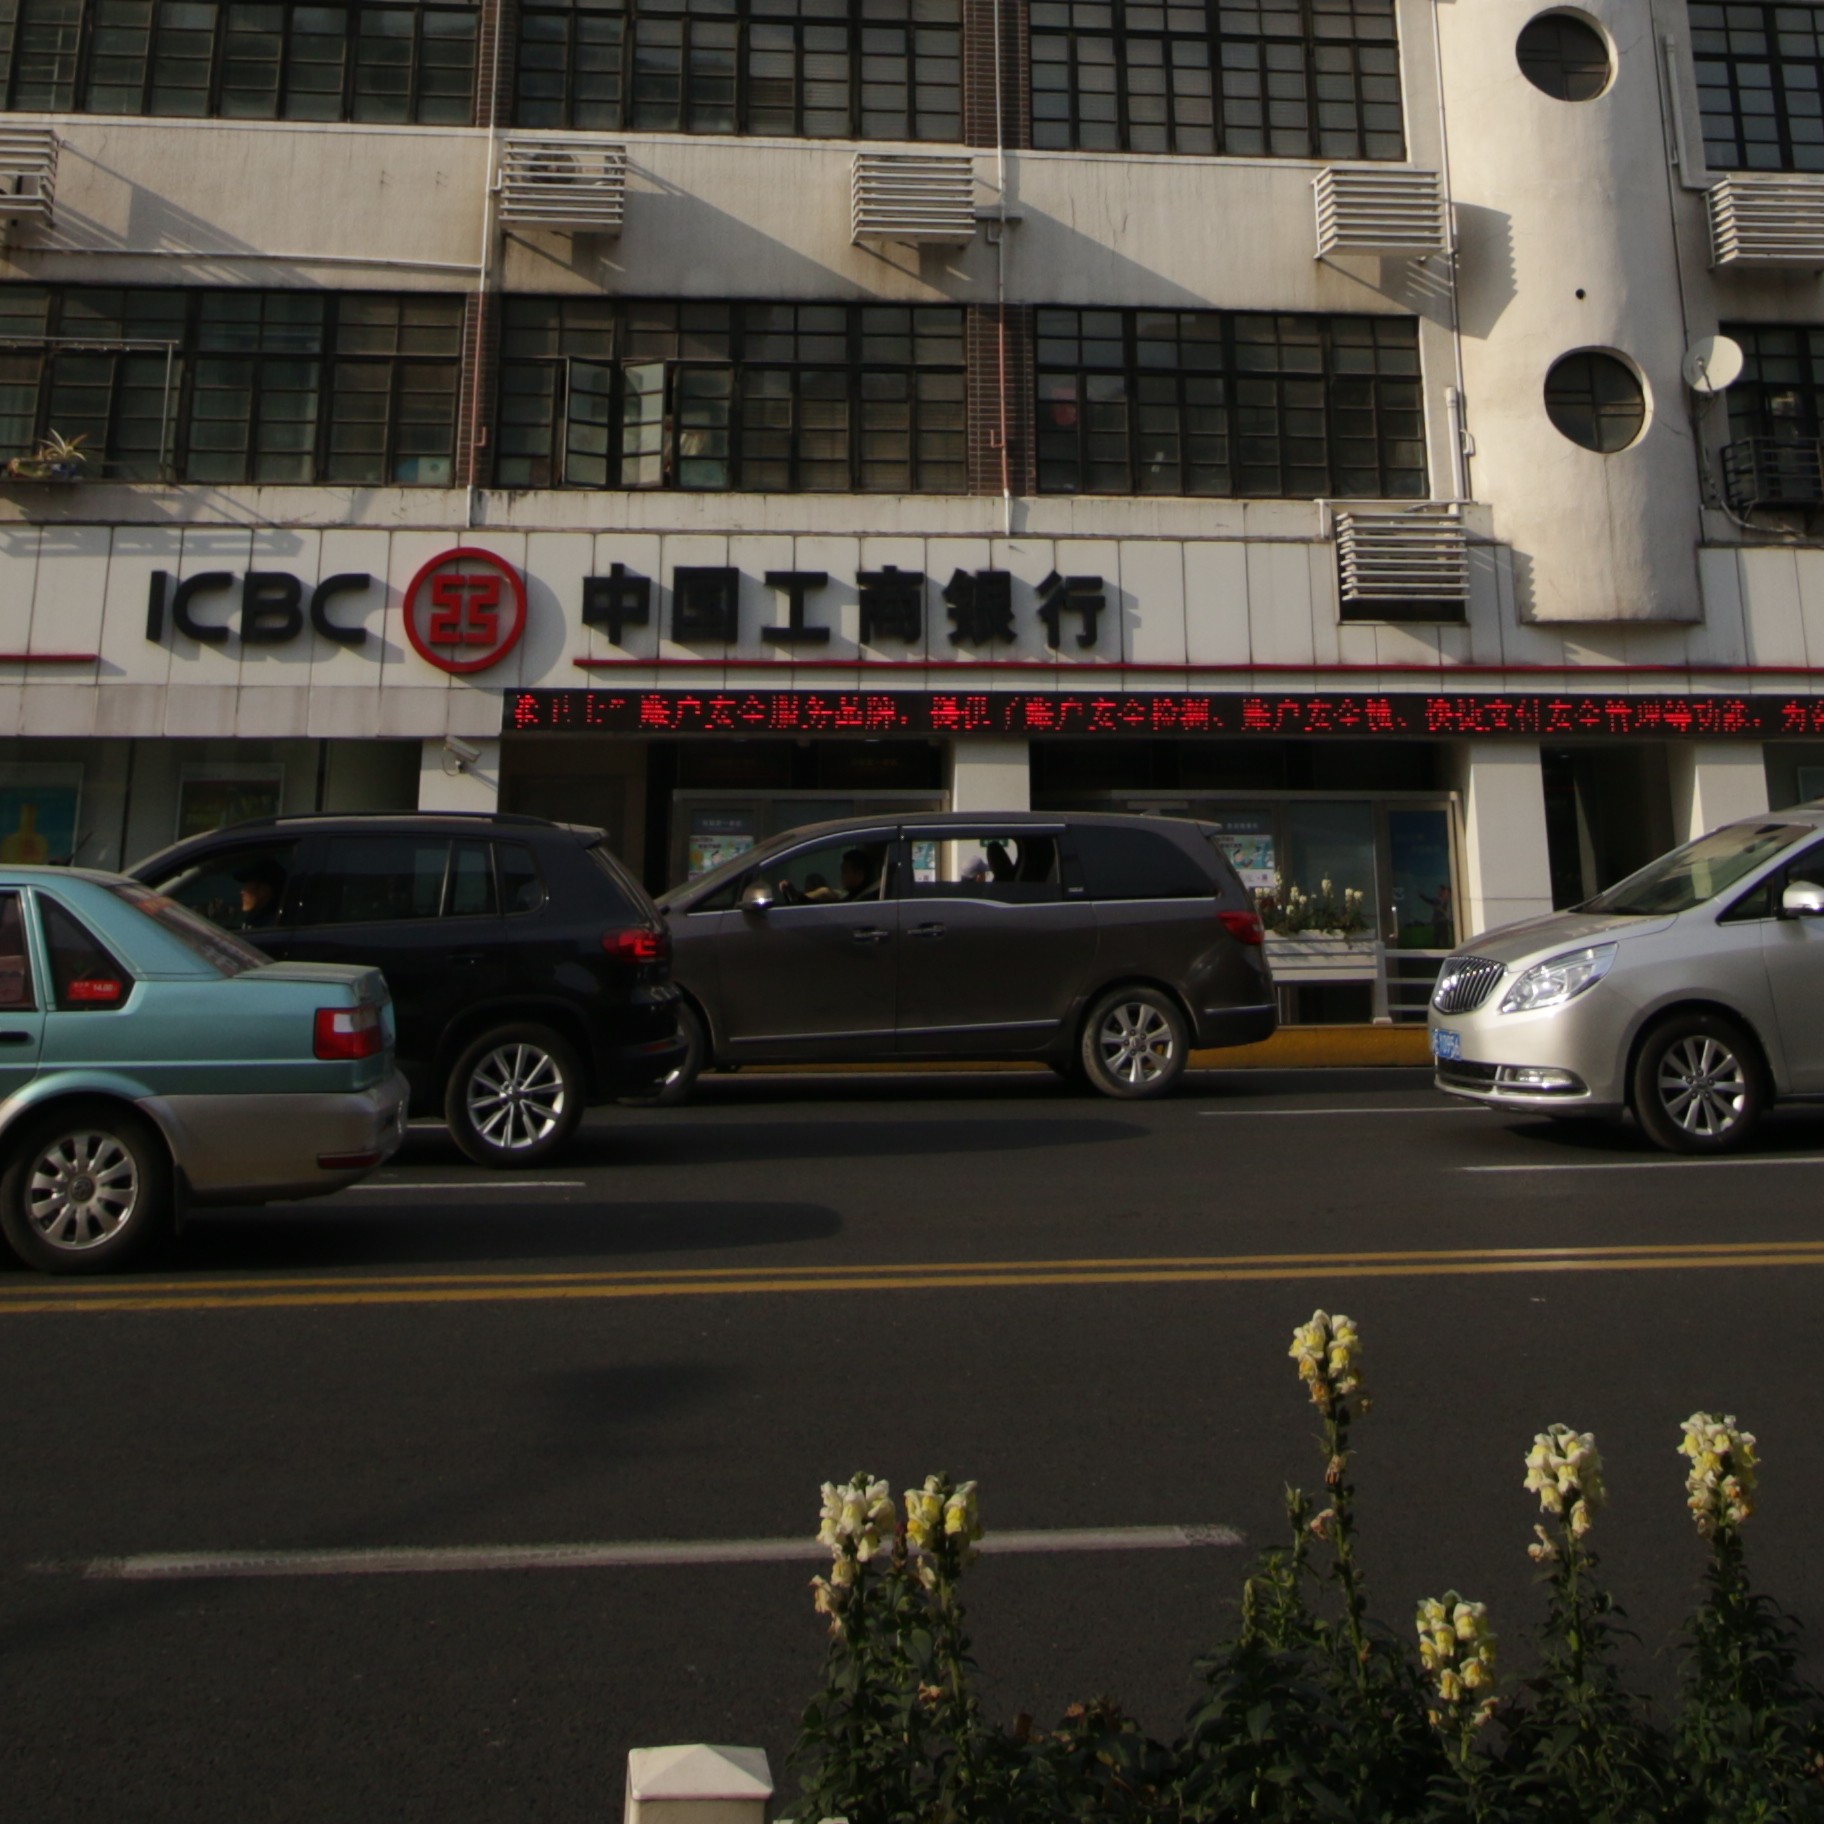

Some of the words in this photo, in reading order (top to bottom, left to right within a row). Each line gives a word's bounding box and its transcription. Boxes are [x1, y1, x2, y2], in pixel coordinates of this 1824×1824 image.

[145, 568, 372, 646] ICBC
[581, 562, 1107, 651] 中国工商银行
